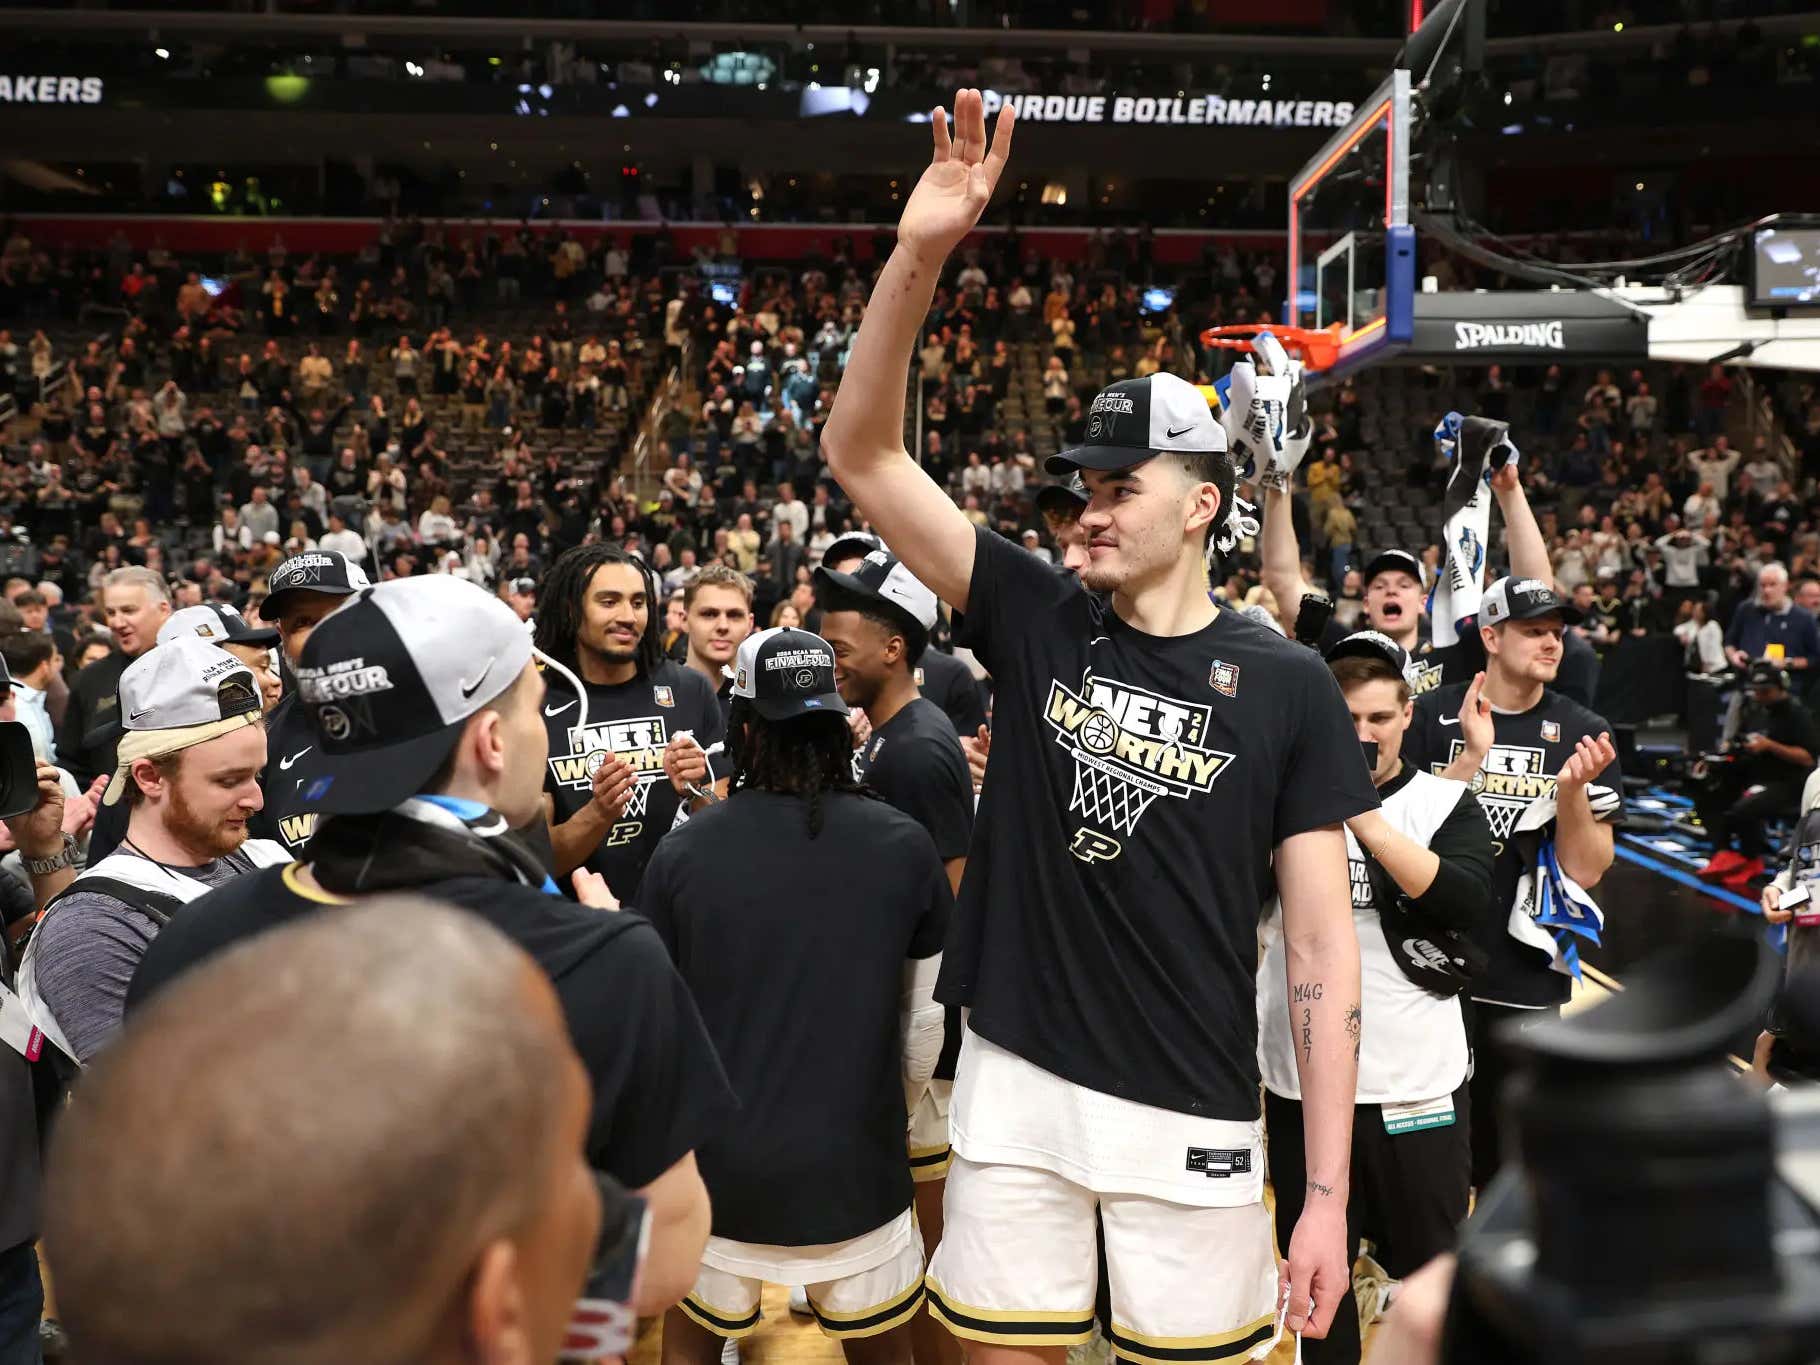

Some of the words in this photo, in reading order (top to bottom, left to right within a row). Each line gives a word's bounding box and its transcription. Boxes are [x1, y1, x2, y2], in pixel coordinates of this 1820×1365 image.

[0, 75, 103, 103] AKERS
[1113, 96, 1355, 127] BOILERMAKERS
[1455, 321, 1565, 350] SPALDING
[316, 665, 394, 701] FOUR
[1090, 682, 1191, 739] NET
[582, 721, 653, 754] NET
[1050, 688, 1223, 786] WORTHY
[1077, 752, 1105, 769] MIDWEST
[1105, 765, 1135, 783] REGIONAL
[1135, 778, 1161, 793] CHAMPS
[1483, 747, 1532, 775] ET
[1415, 939, 1450, 966] NIKE
[1293, 983, 1323, 1003] M4G
[1235, 1156, 1244, 1166] 52
